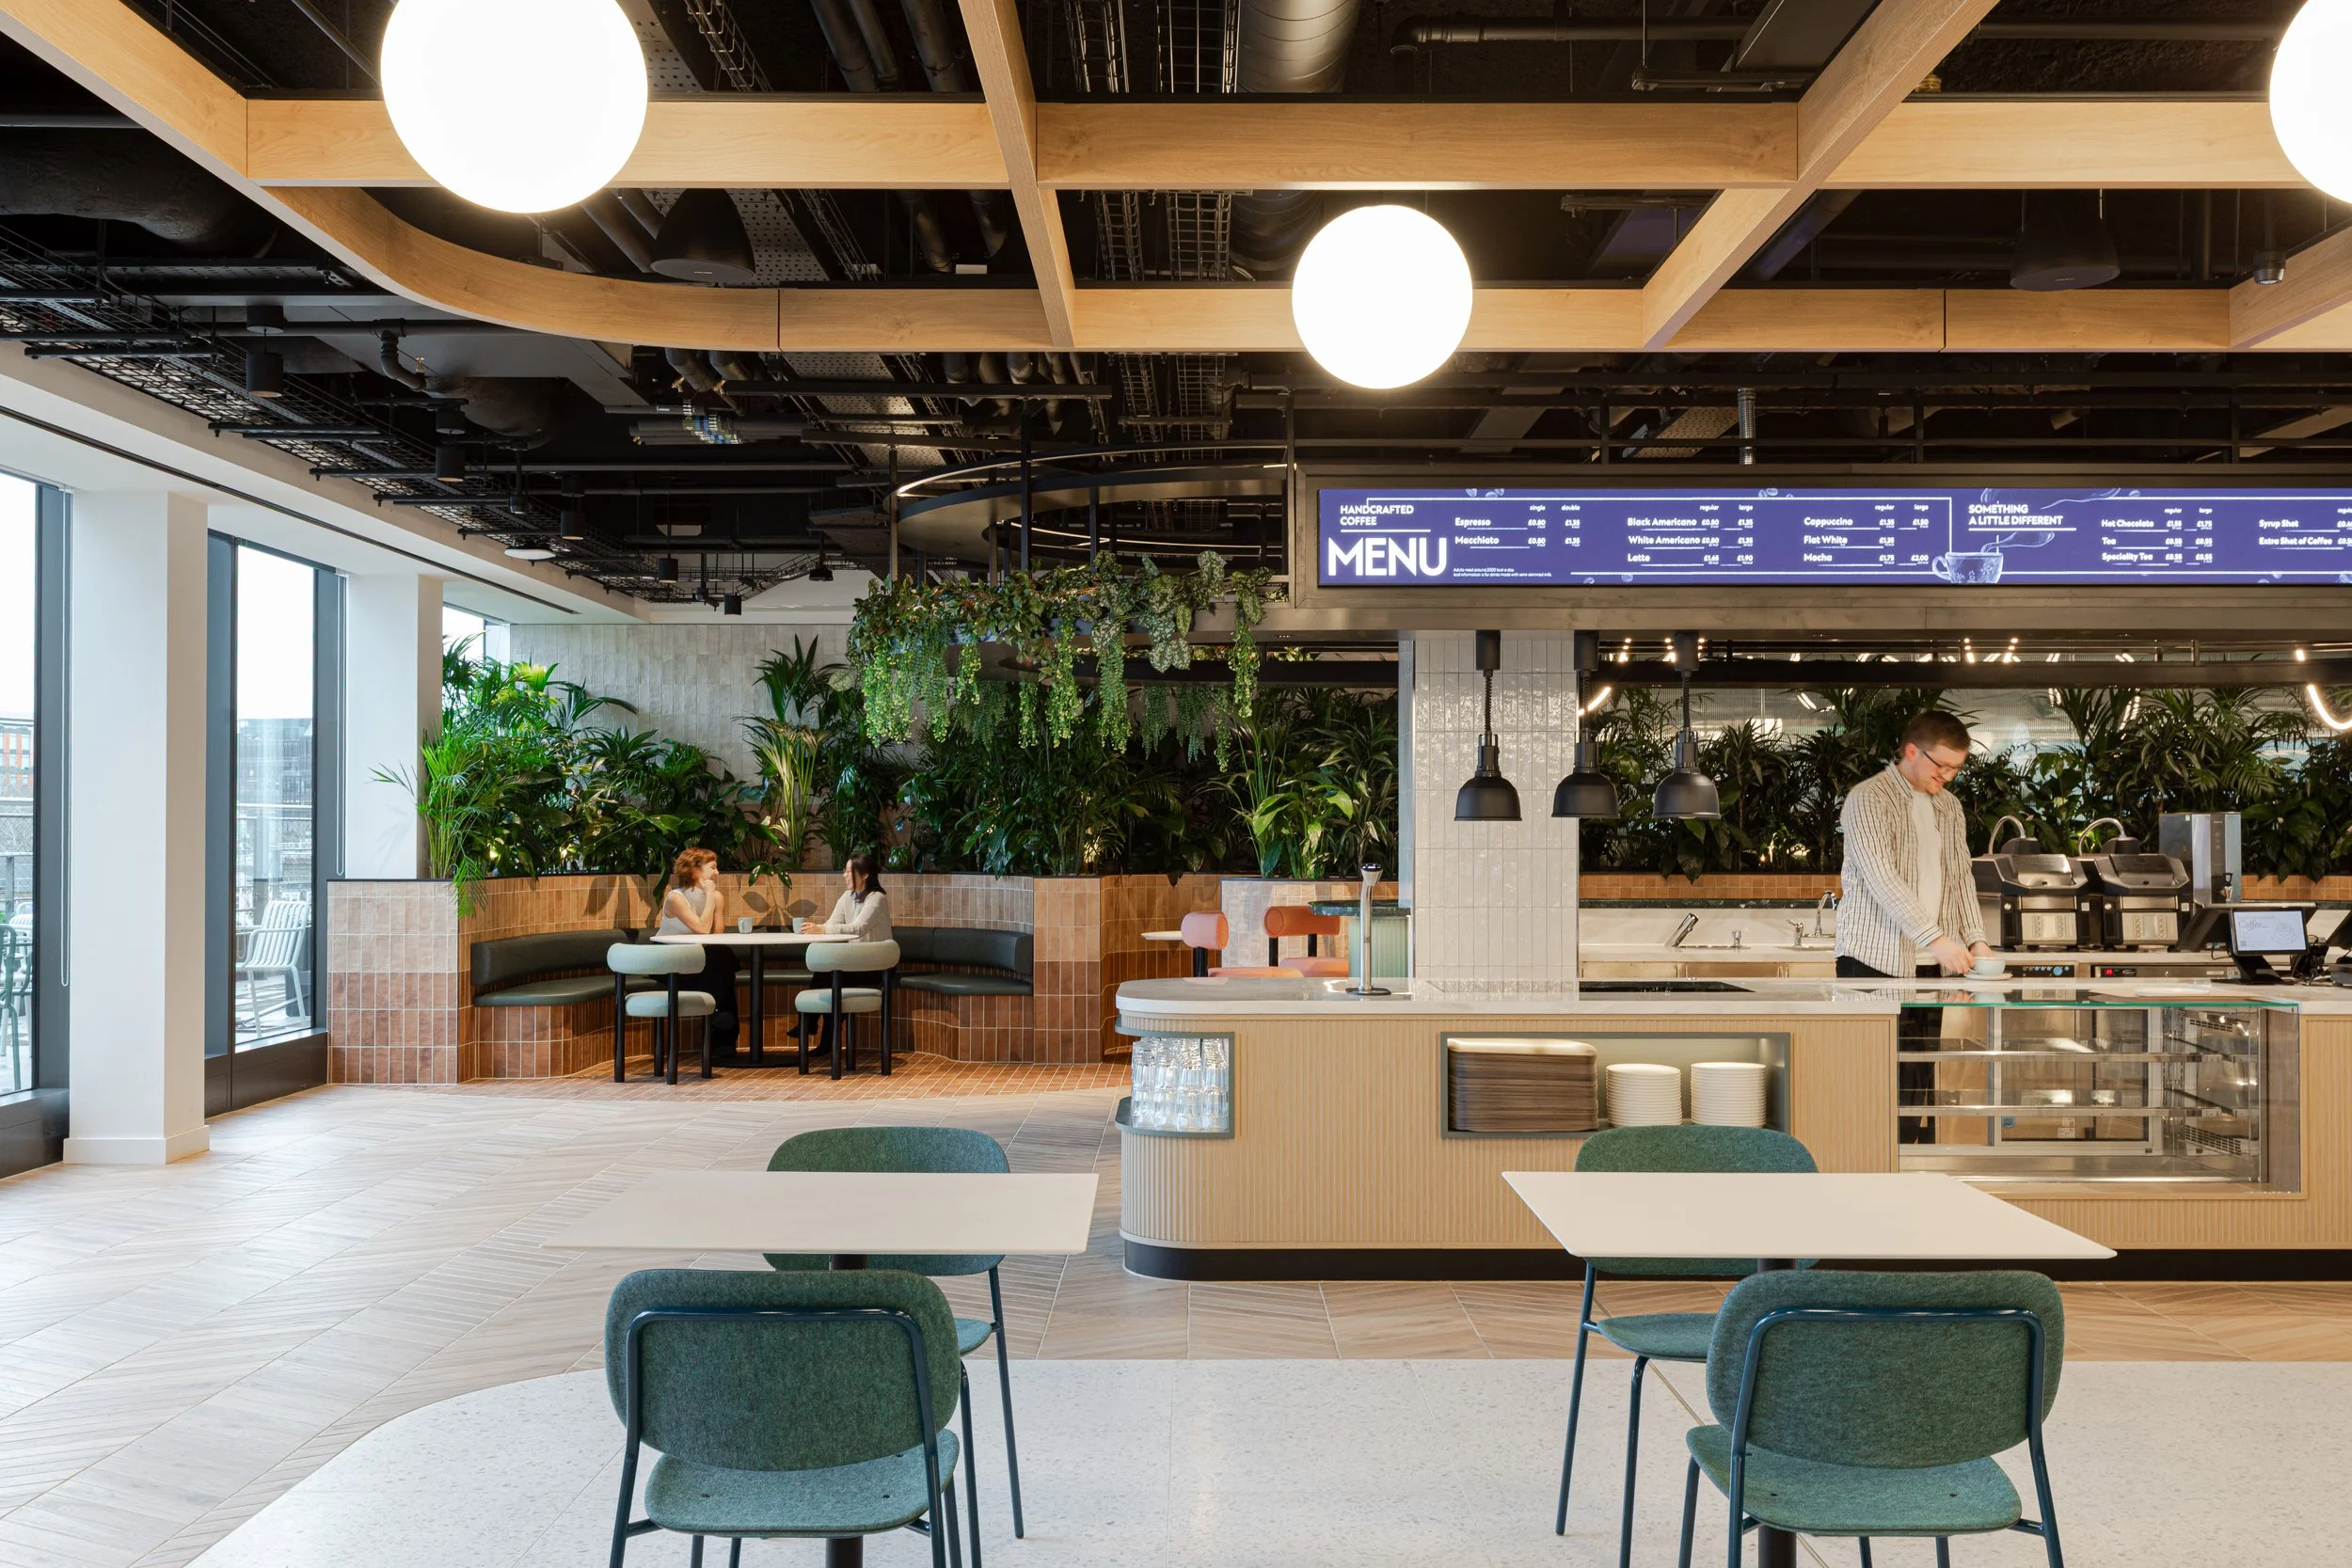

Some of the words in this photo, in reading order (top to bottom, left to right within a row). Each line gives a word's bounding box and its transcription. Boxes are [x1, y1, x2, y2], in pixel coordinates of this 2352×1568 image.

[1340, 505, 1415, 515] HANDCRAFTED
[1968, 505, 2028, 514] SOMETHING
[1340, 516, 1377, 526] COFFEE
[1455, 517, 1491, 528] Espresso
[1628, 517, 1650, 526] Black
[1652, 517, 1697, 526] Americano
[1804, 517, 1853, 528] Cappuccino
[1968, 515, 1977, 525] A
[1978, 515, 2010, 525] LITTLE
[2010, 515, 2063, 525] DIFFERENT
[2259, 519, 2281, 529] Syrup
[1804, 535, 1820, 544] Flat
[1821, 535, 1848, 545] White
[1328, 537, 1447, 576] MENU
[1628, 553, 1650, 562] Latte
[1804, 553, 1832, 562] Mocha
[2138, 552, 2153, 561] Tea
